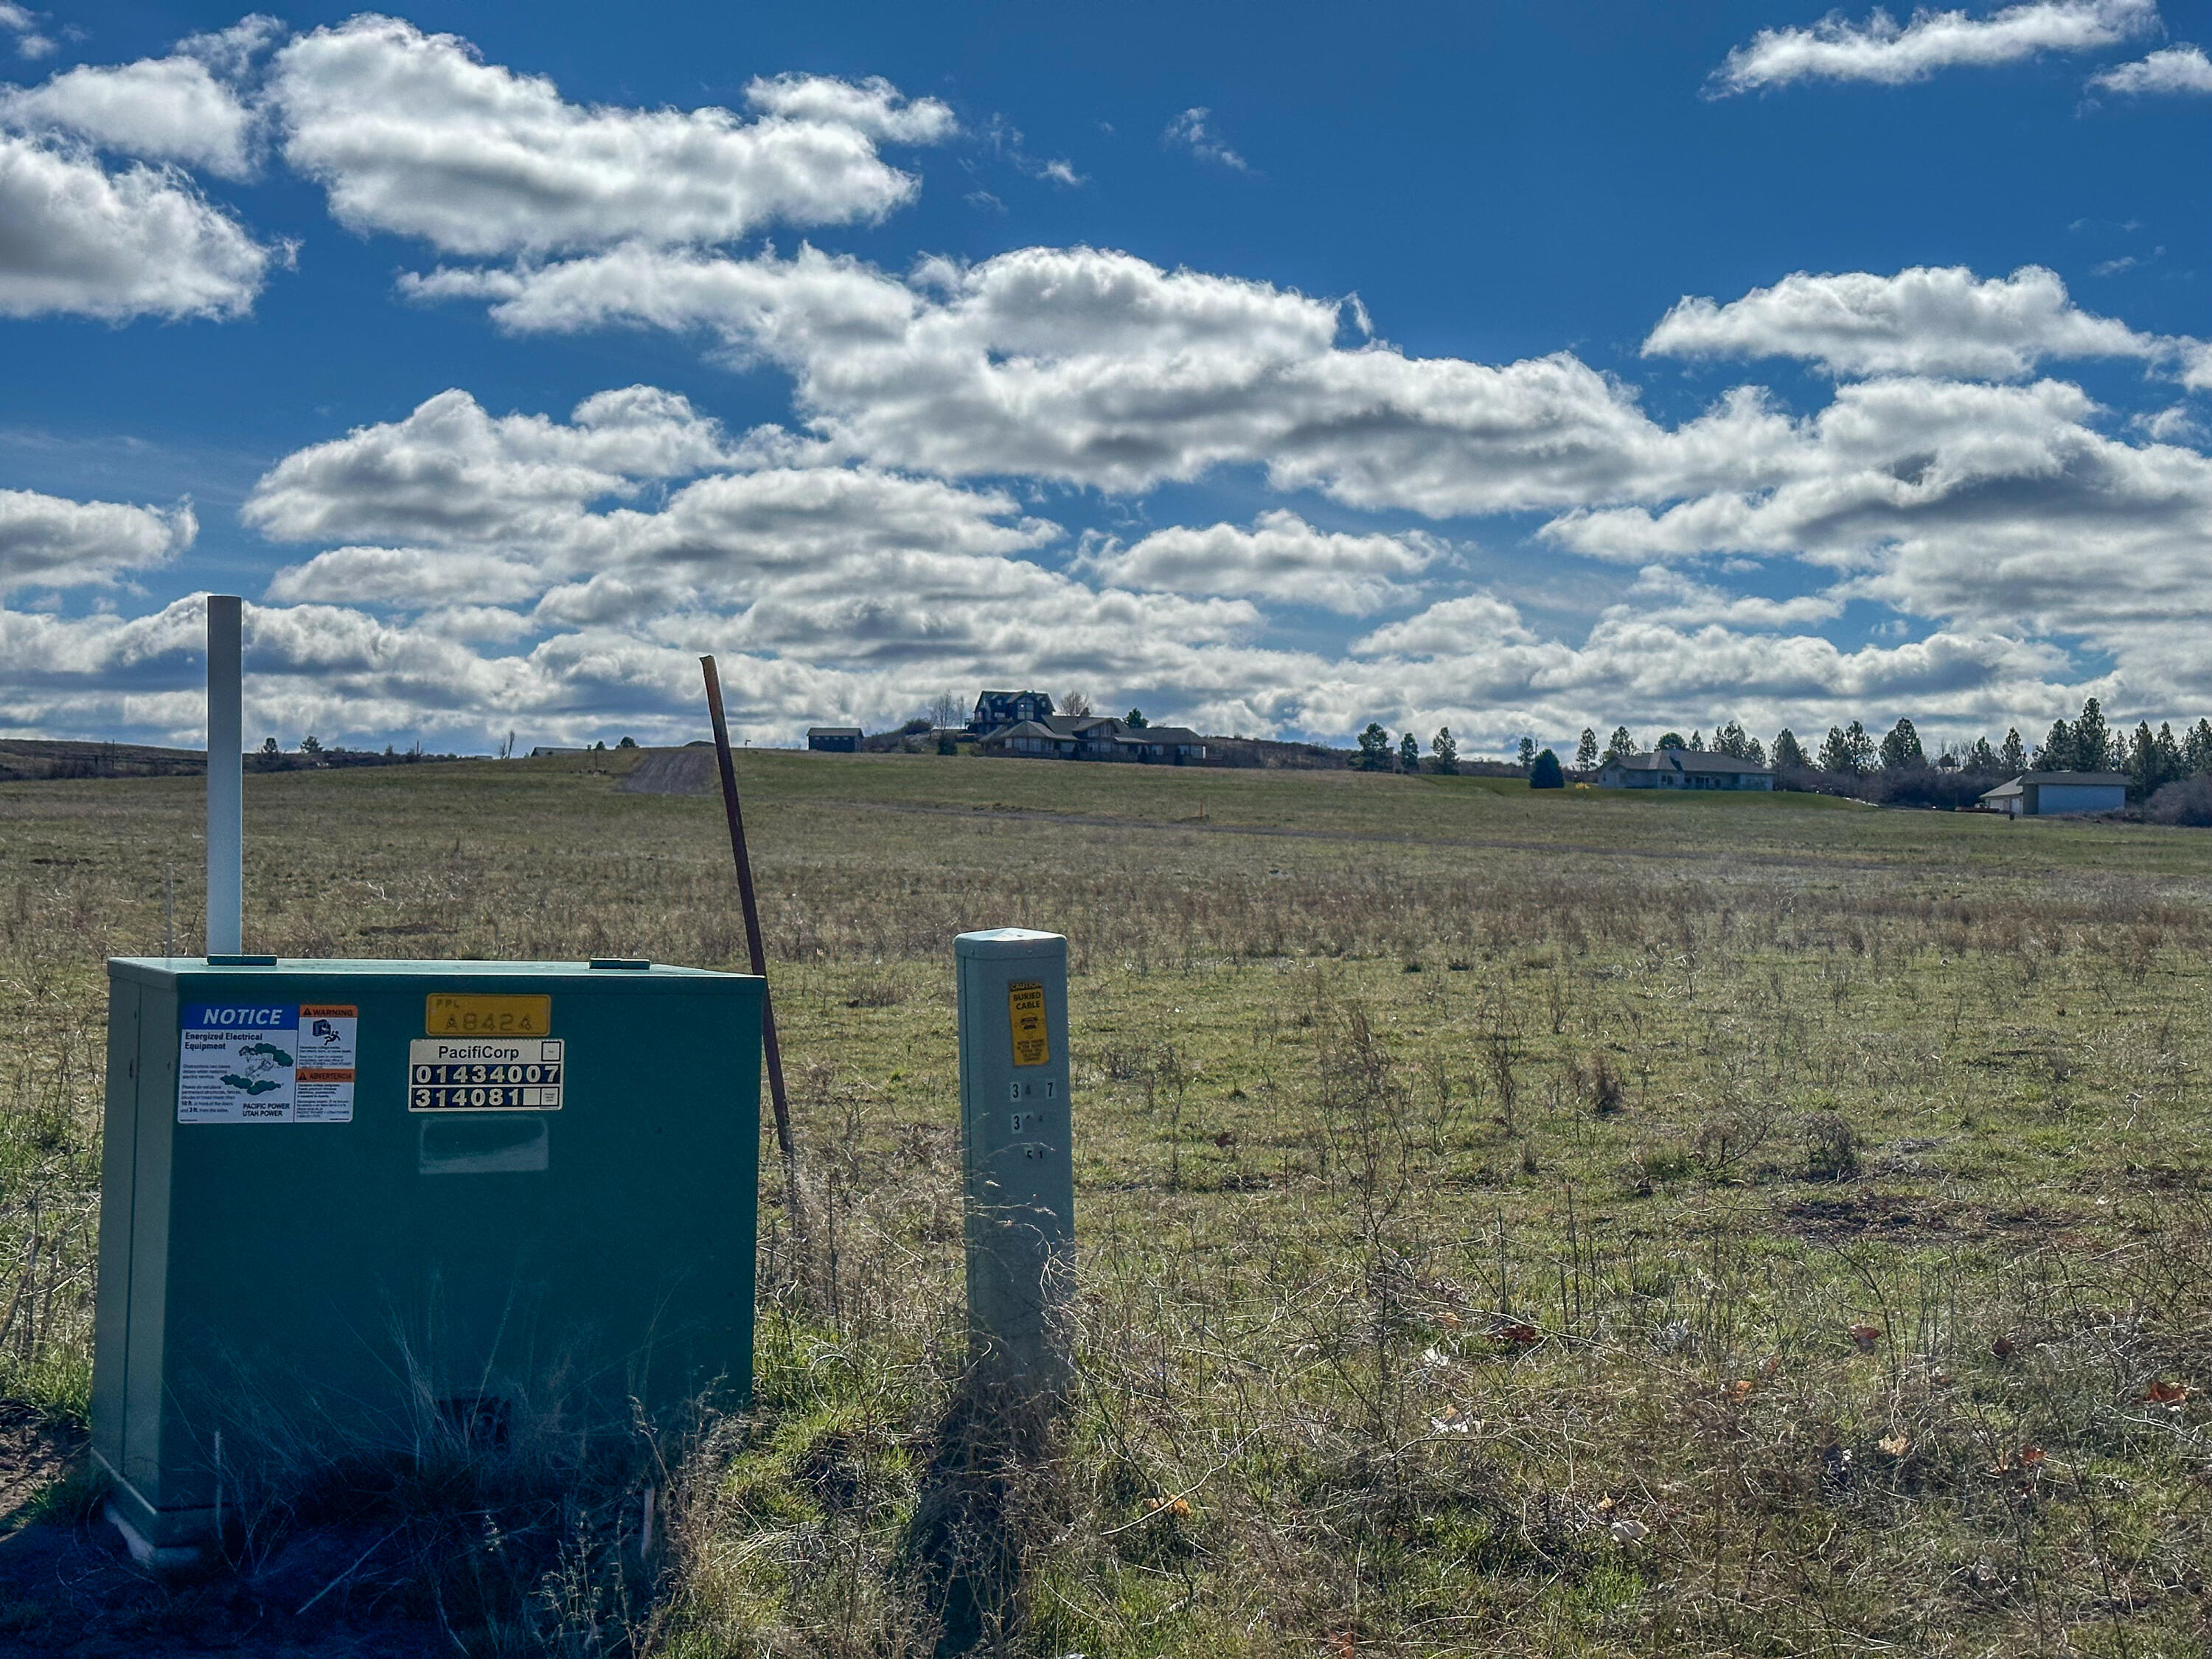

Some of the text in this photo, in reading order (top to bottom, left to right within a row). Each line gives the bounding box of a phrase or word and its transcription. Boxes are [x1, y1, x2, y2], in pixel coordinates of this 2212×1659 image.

[1013, 992, 1041, 1001] BURIED
[436, 999, 460, 1009] PPL
[1016, 1001, 1040, 1010] CABLE
[203, 1009, 283, 1025] NOTICE
[445, 1012, 532, 1032] A8424
[185, 1032, 262, 1041] Energized Electrical
[184, 1042, 226, 1051] Equipment
[438, 1046, 520, 1062] PacifiCorp
[415, 1065, 559, 1083] 01434007
[414, 1088, 520, 1107] 314081
